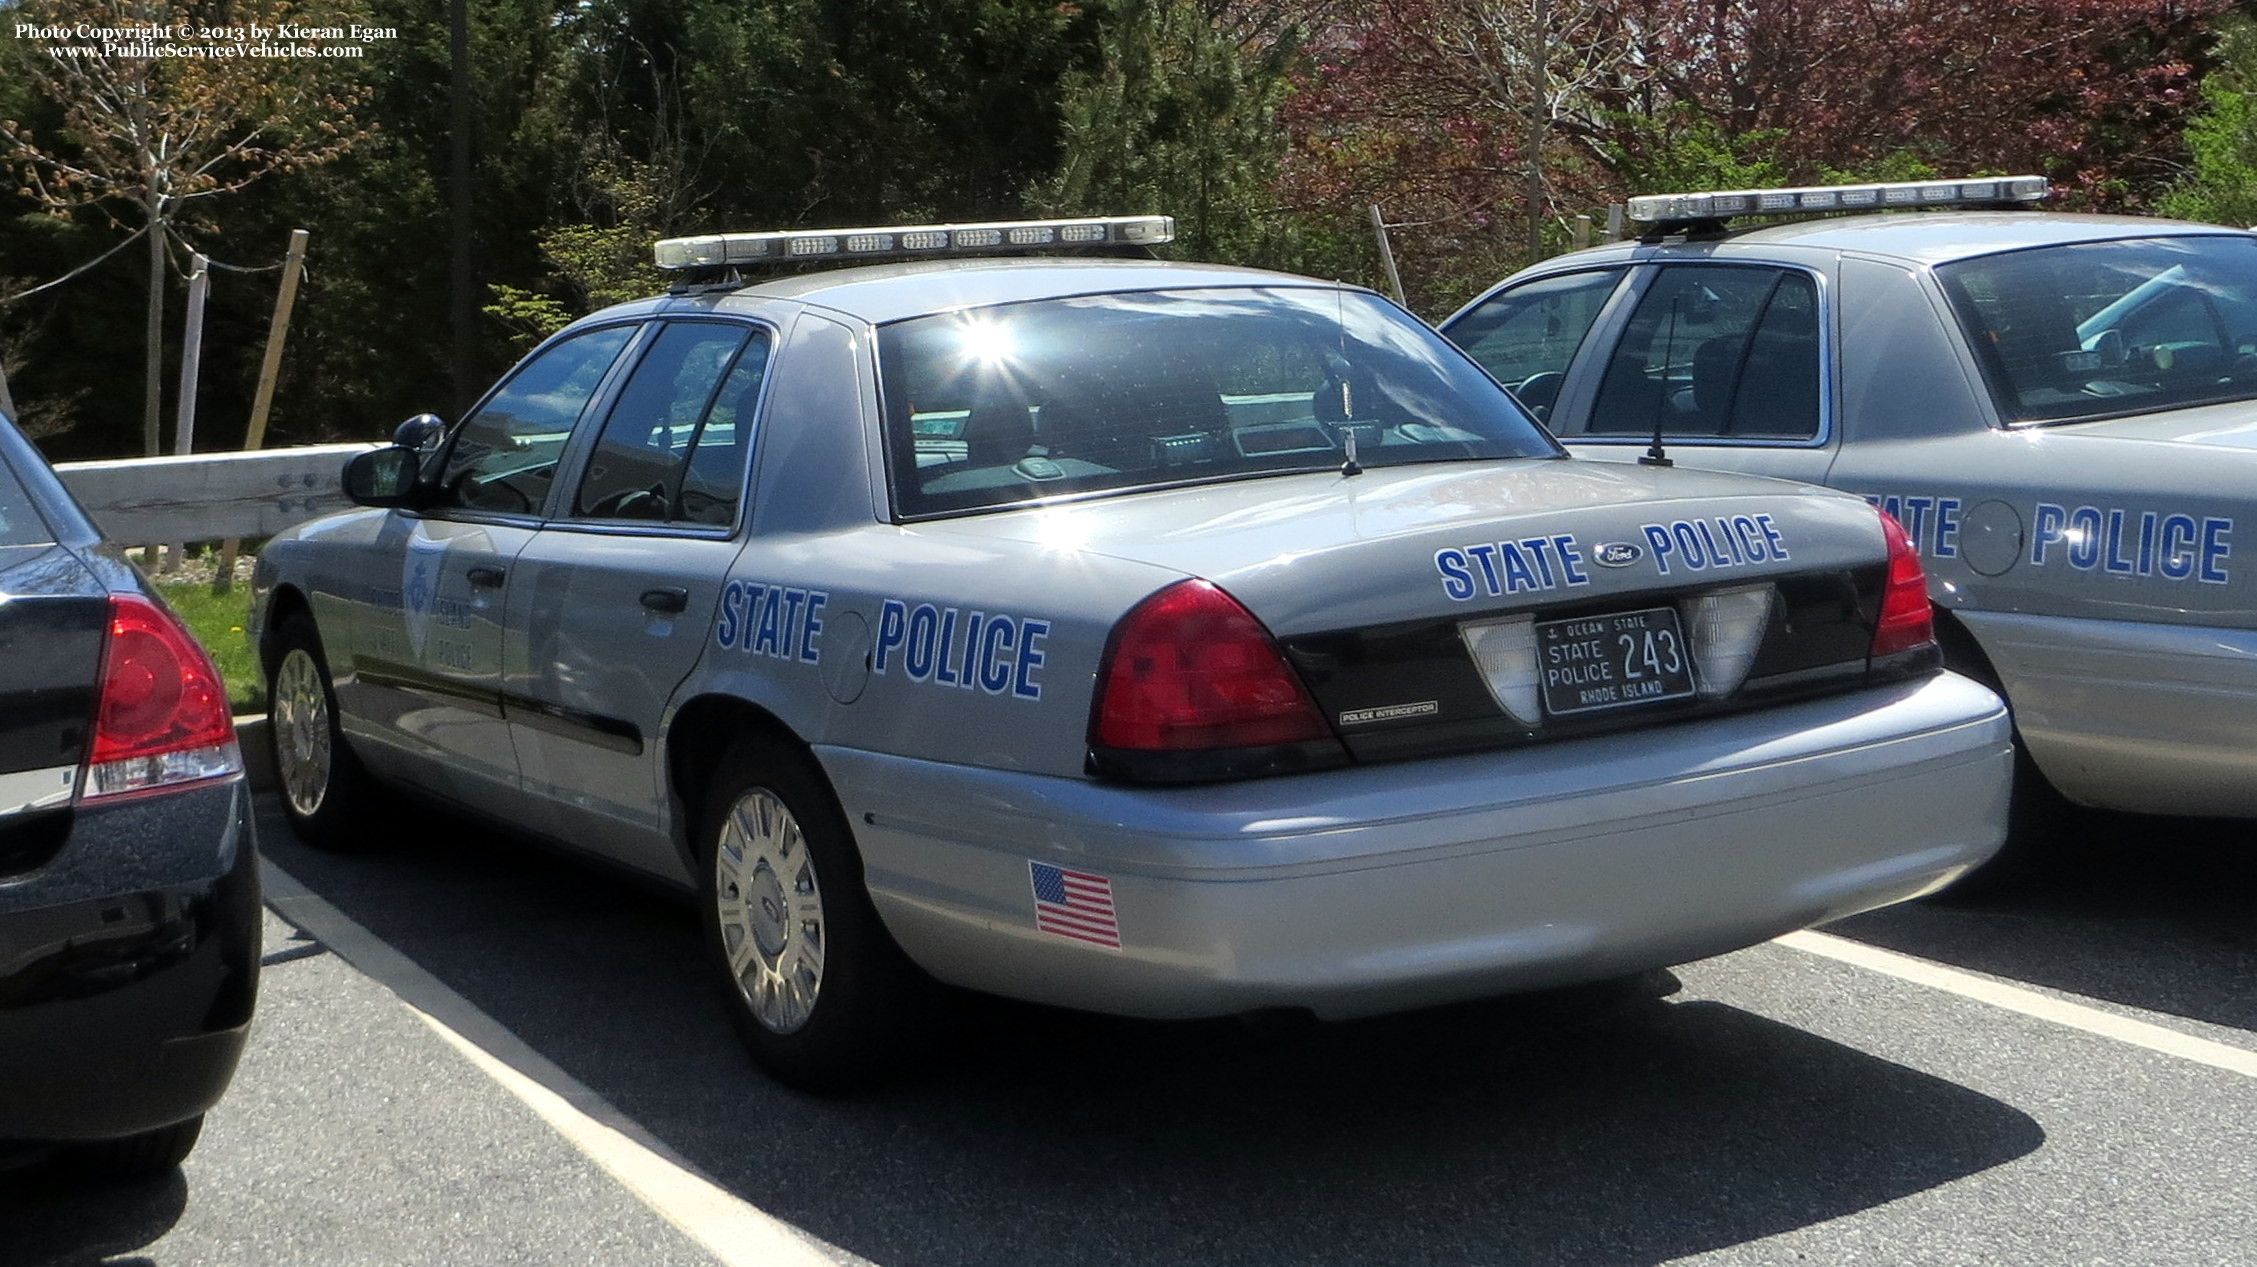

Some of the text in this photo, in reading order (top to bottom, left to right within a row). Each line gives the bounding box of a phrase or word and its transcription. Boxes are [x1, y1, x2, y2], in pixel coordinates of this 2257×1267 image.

[2031, 502, 2234, 584] POLICE
[1434, 513, 1791, 600] STATE Ford POLICE
[1567, 616, 1646, 637] OCEAN STATE
[717, 579, 1051, 701] STATE POLICE
[1549, 640, 1604, 664] STATE
[1618, 629, 1681, 679] 243
[1549, 661, 1613, 687] POLICE
[1580, 680, 1664, 704] RHODE ISLAND
[1343, 711, 1374, 722] POLICE
